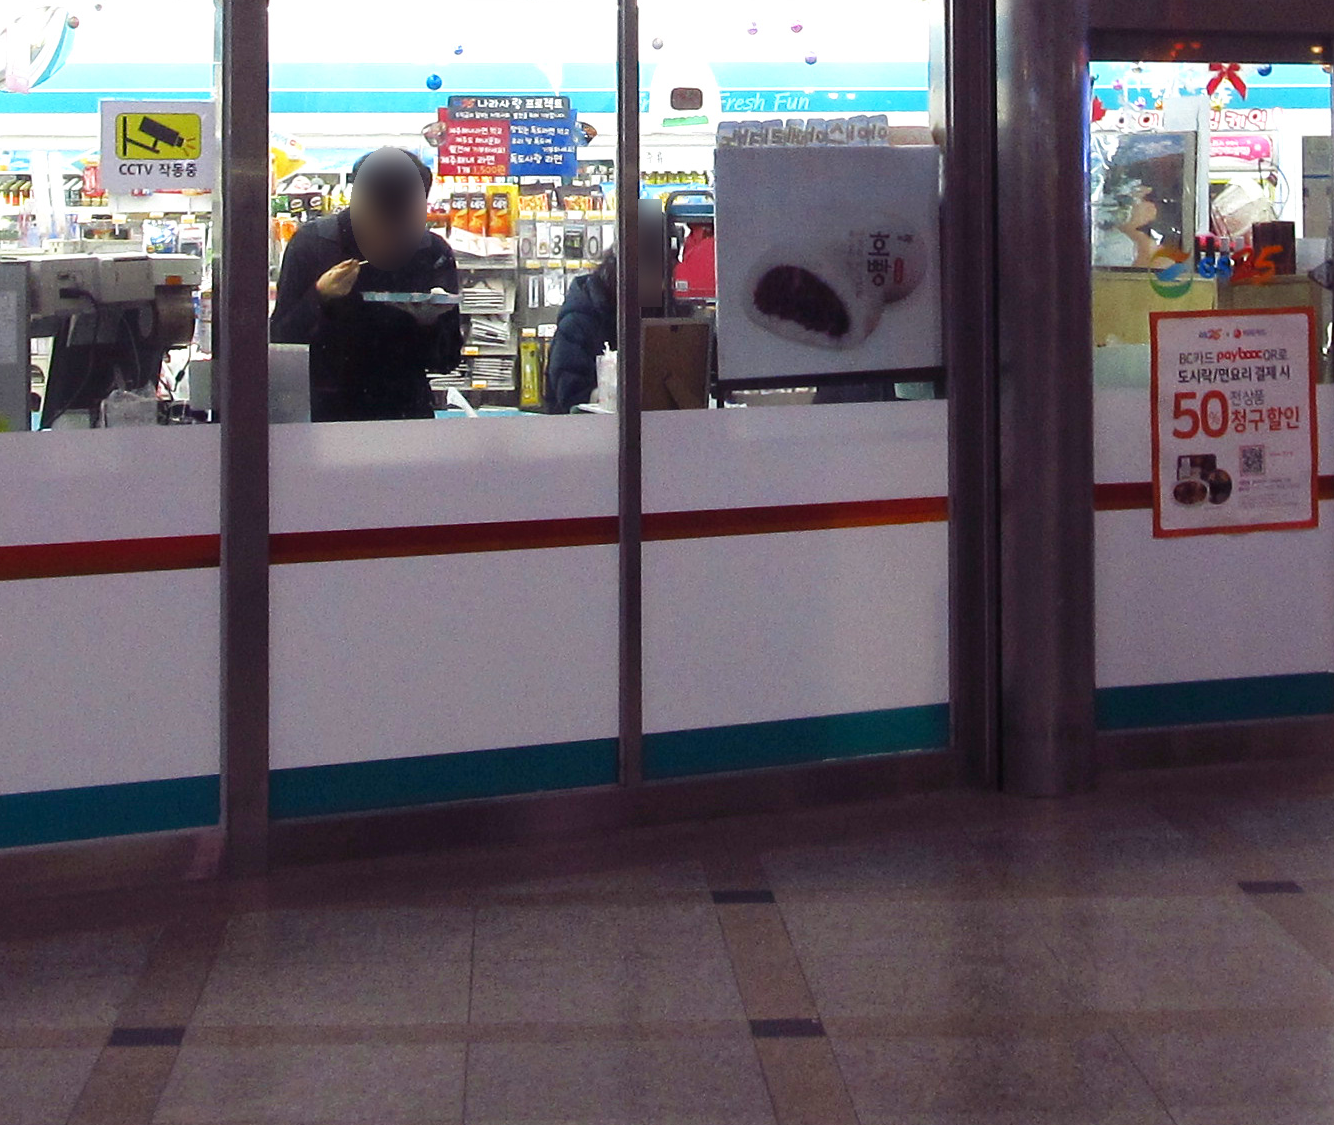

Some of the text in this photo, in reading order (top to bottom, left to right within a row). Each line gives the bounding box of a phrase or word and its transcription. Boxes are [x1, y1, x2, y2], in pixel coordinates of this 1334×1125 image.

[525, 97, 564, 110] 프로젝트
[719, 92, 811, 111] Fresh Fun
[119, 163, 198, 178] CCTV 작동중
[868, 231, 892, 287] 호빵
[1198, 245, 1284, 285] GS25
[1179, 351, 1215, 365] BC카드
[1216, 346, 1263, 363] paybooc
[1178, 364, 1291, 384] 도시락/면요리 결제 시
[1230, 405, 1300, 434] 청구할인
